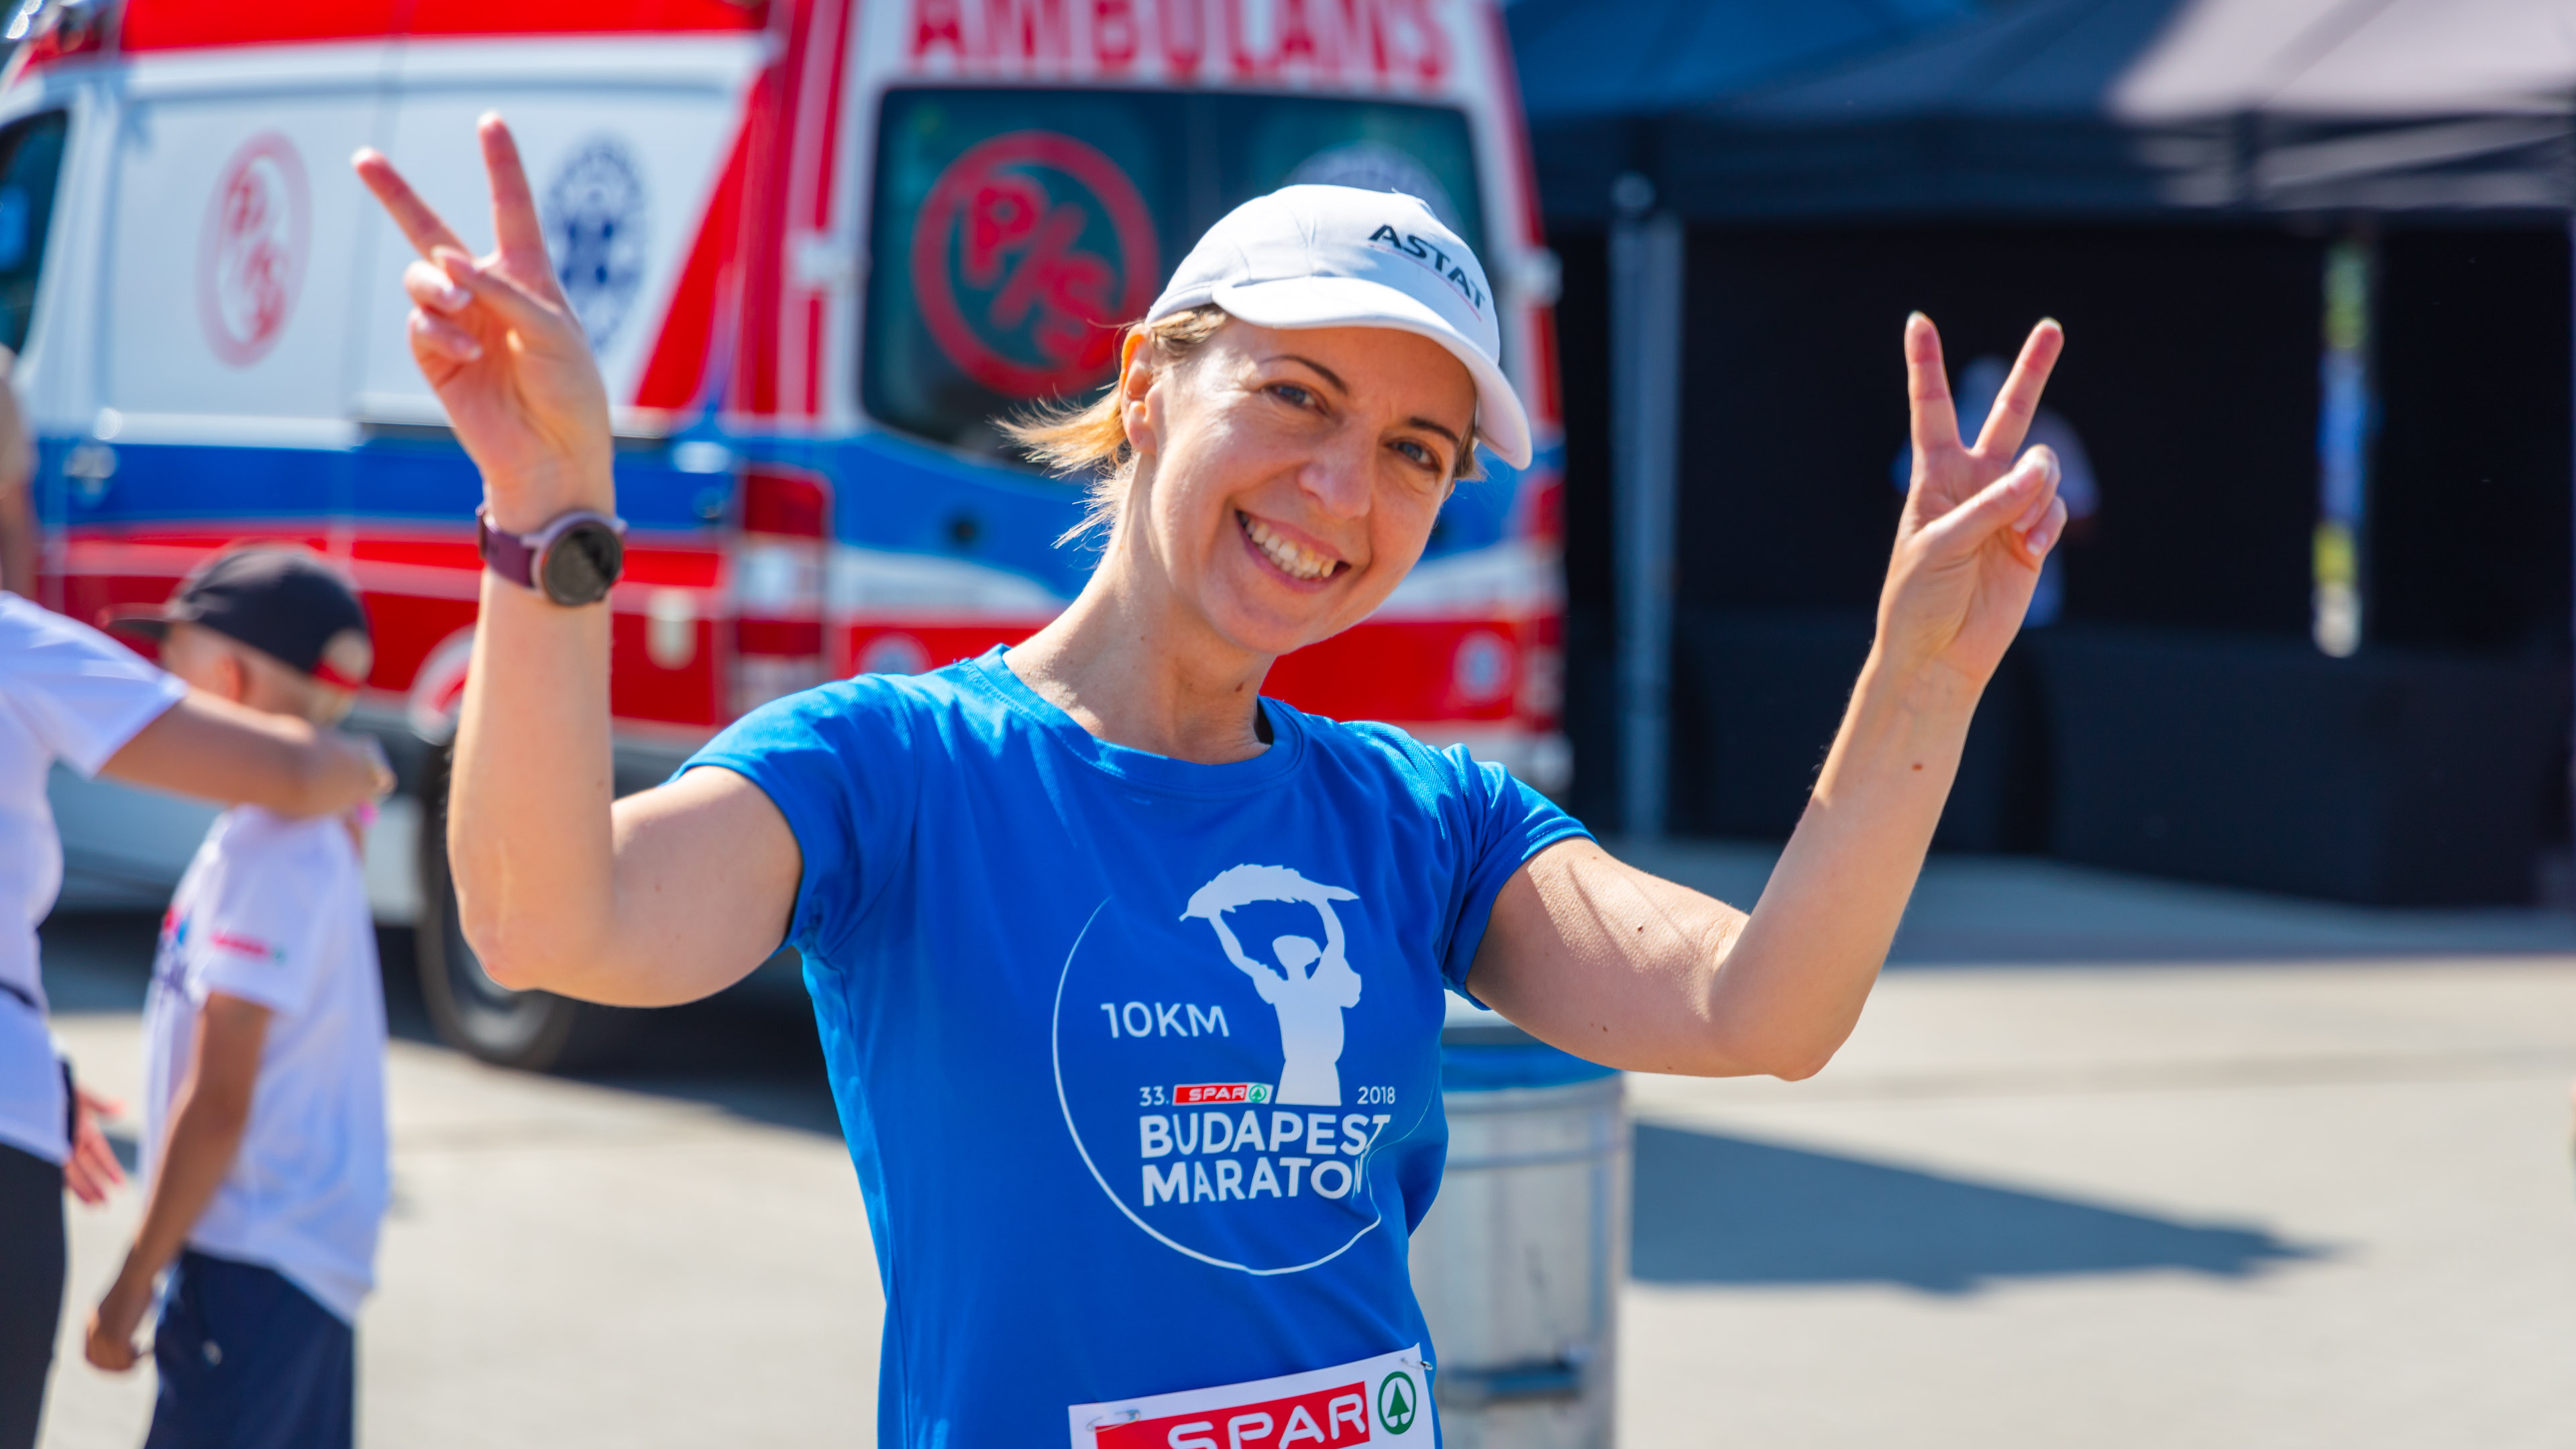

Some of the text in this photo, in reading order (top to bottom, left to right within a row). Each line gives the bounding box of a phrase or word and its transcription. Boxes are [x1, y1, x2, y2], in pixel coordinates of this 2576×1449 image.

[1368, 223, 1486, 310] ASTAT
[1101, 1002, 1229, 1038] 10KM
[1139, 1086, 1396, 1106] 33. SPAR 2018
[1140, 1110, 1391, 1158] BUDAPEST
[1167, 1393, 1367, 1449] SPAR
